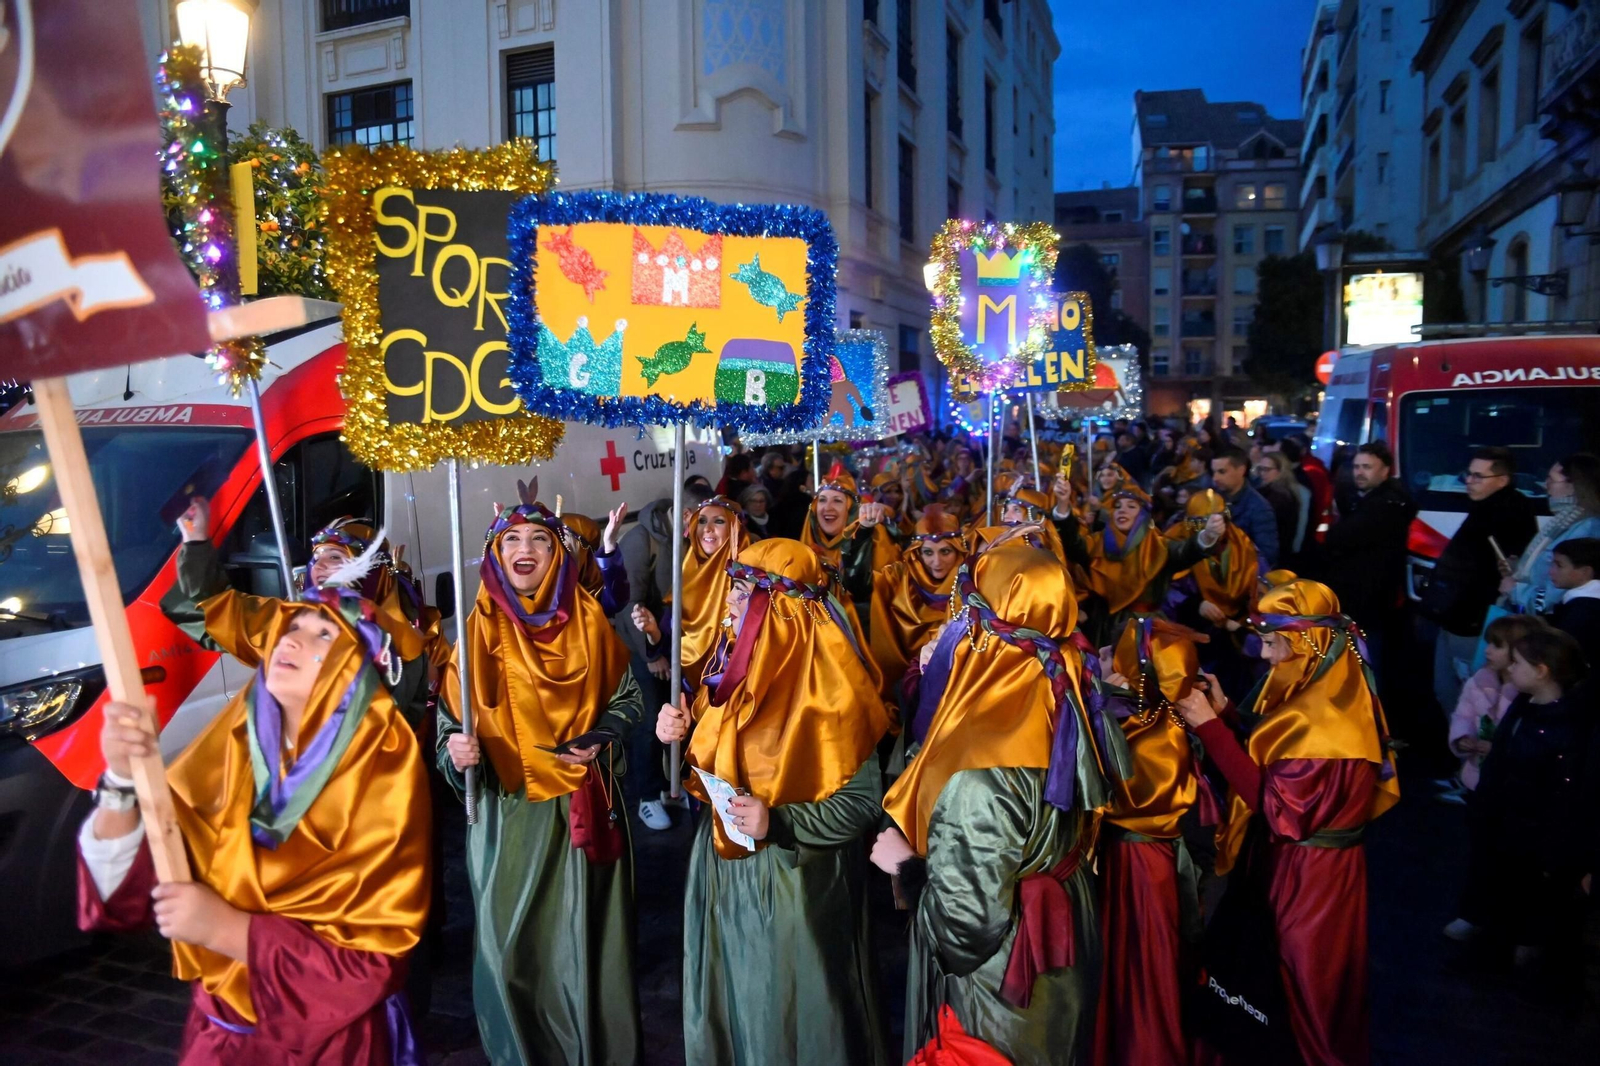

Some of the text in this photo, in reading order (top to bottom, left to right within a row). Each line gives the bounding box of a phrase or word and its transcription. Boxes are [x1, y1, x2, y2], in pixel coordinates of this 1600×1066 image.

[373, 187, 512, 332] SPQR
[661, 266, 689, 305] M
[976, 294, 1017, 344] M
[380, 329, 521, 424] CDG
[568, 353, 590, 388] G
[744, 369, 766, 406] B
[633, 448, 696, 471] Cruz Rja
